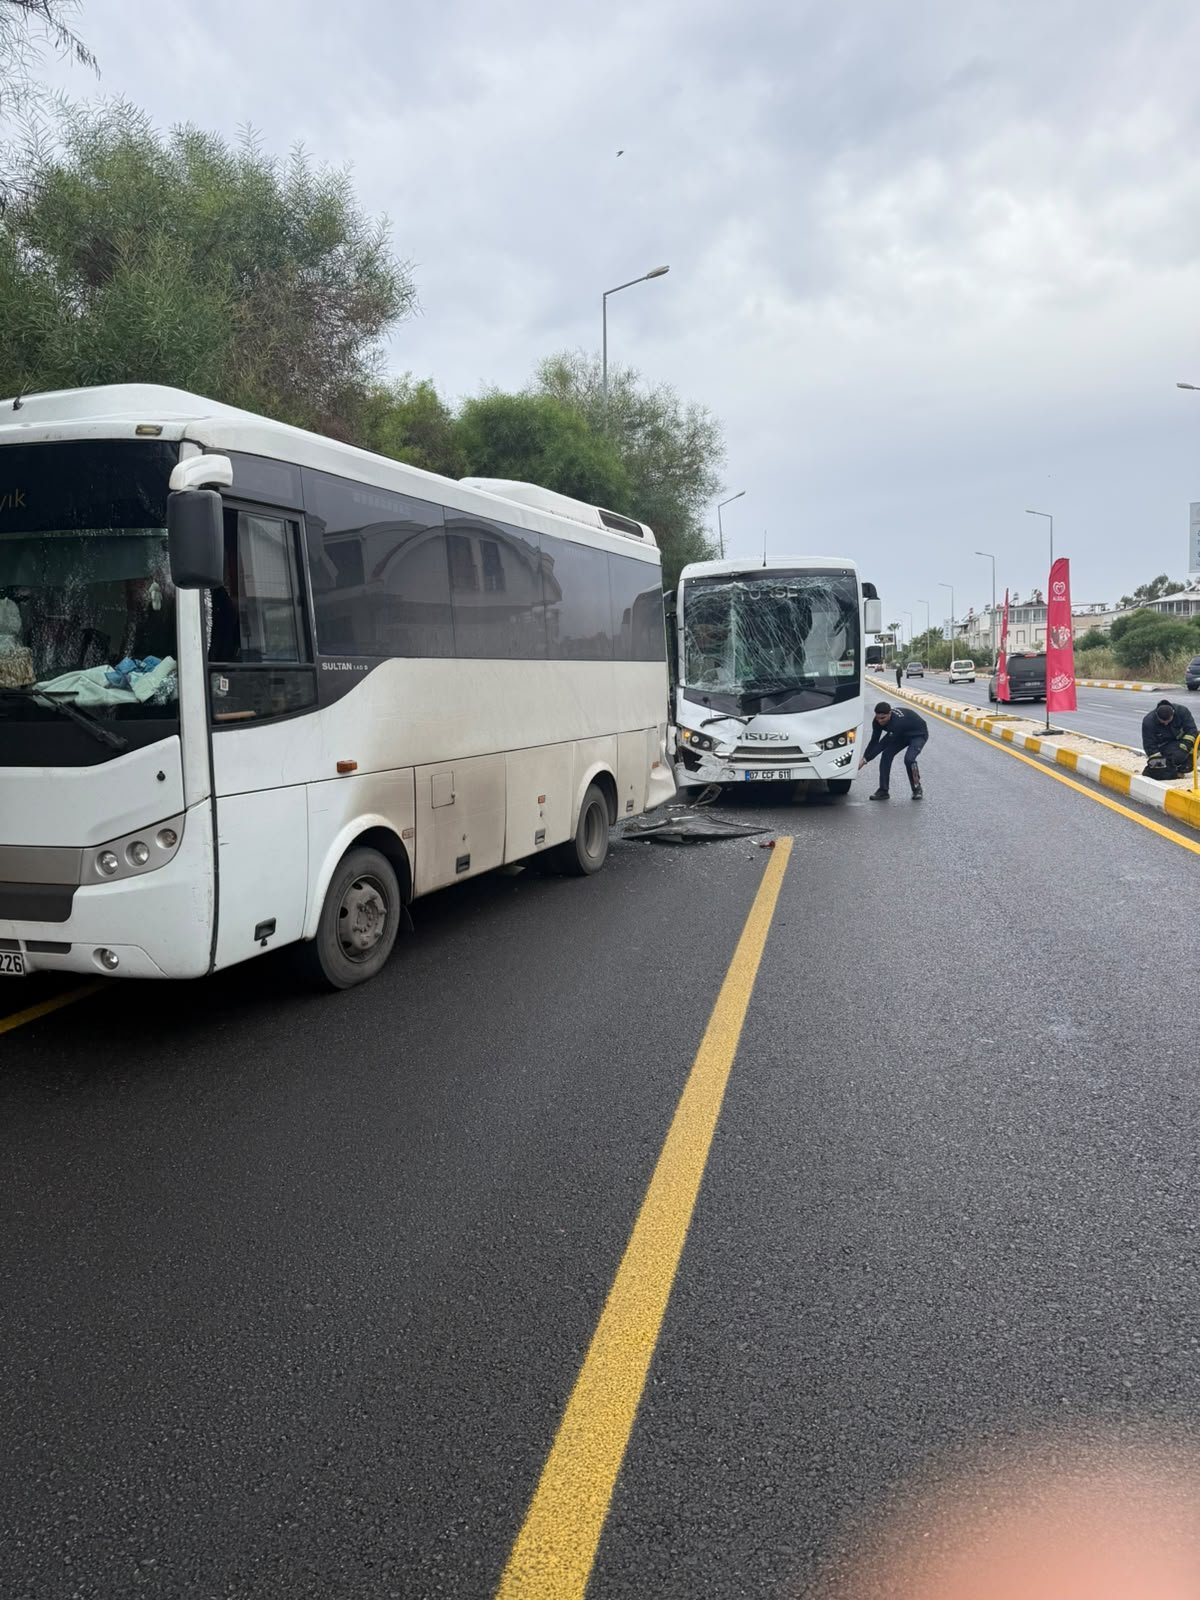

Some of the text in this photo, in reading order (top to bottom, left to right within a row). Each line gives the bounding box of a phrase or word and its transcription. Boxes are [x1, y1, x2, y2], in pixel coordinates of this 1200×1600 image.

[321, 662, 353, 671] SULTAN
[744, 731, 790, 741] ISUZU
[750, 771, 759, 780] 07
[762, 771, 775, 780] CCF
